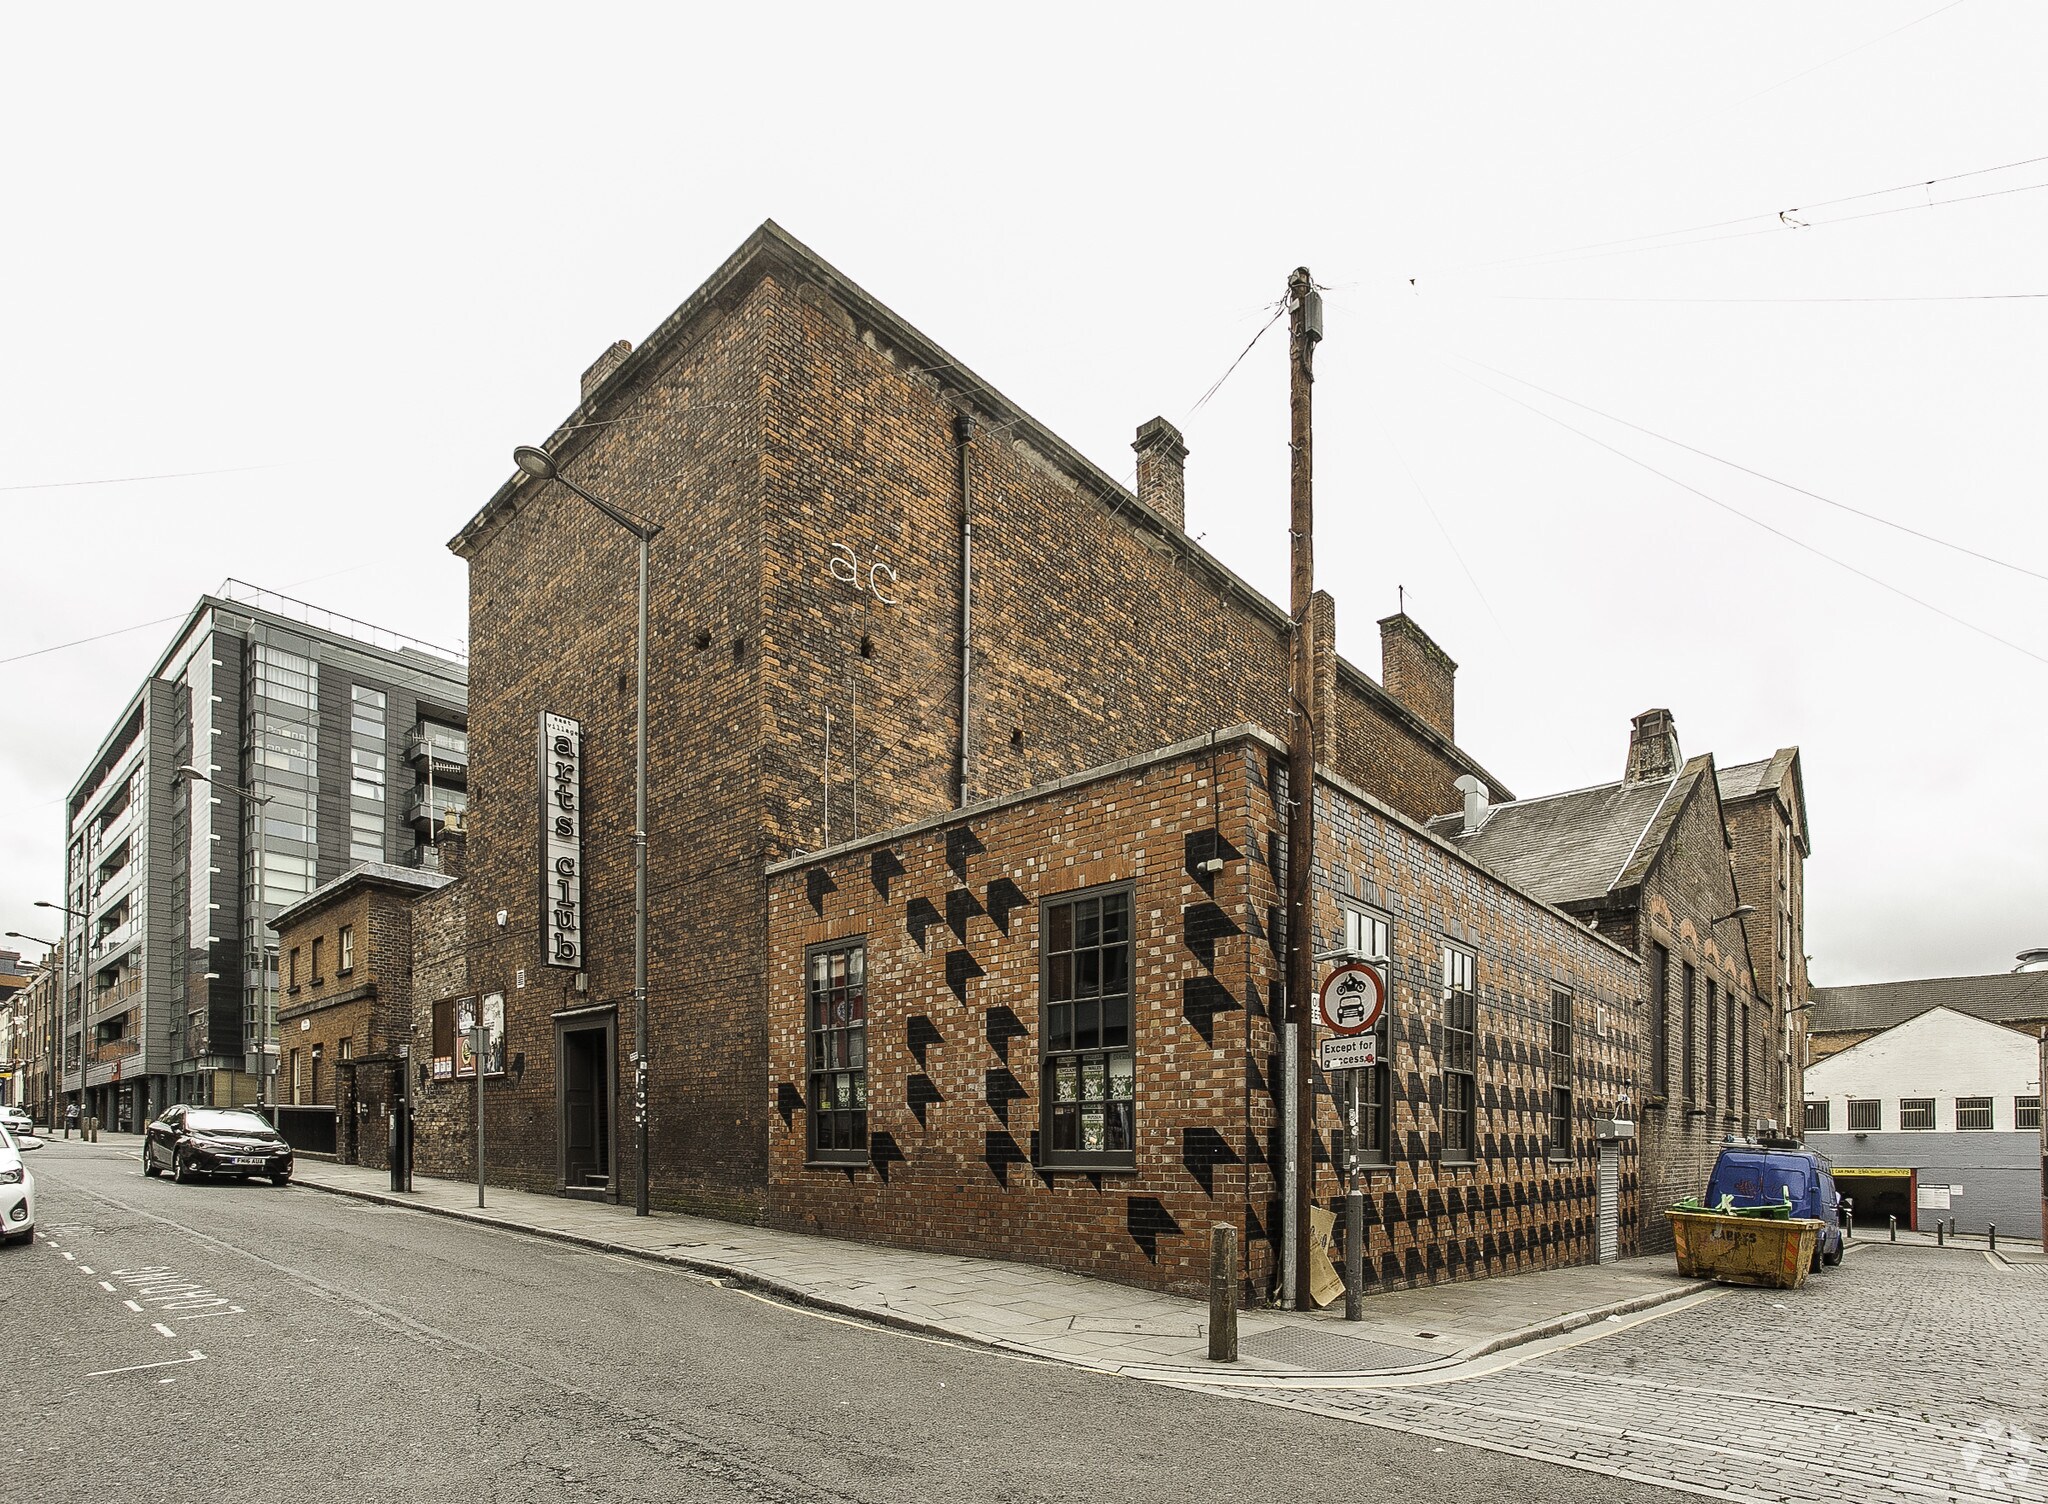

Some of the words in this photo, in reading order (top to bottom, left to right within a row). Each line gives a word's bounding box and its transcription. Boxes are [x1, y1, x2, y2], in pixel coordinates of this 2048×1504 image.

[554, 716, 571, 726] east
[547, 723, 579, 737] village
[554, 735, 576, 837] arts
[554, 856, 577, 960] club
[1324, 1042, 1357, 1054] Except
[1359, 1041, 1373, 1051] for
[1332, 1055, 1364, 1066] ccess
